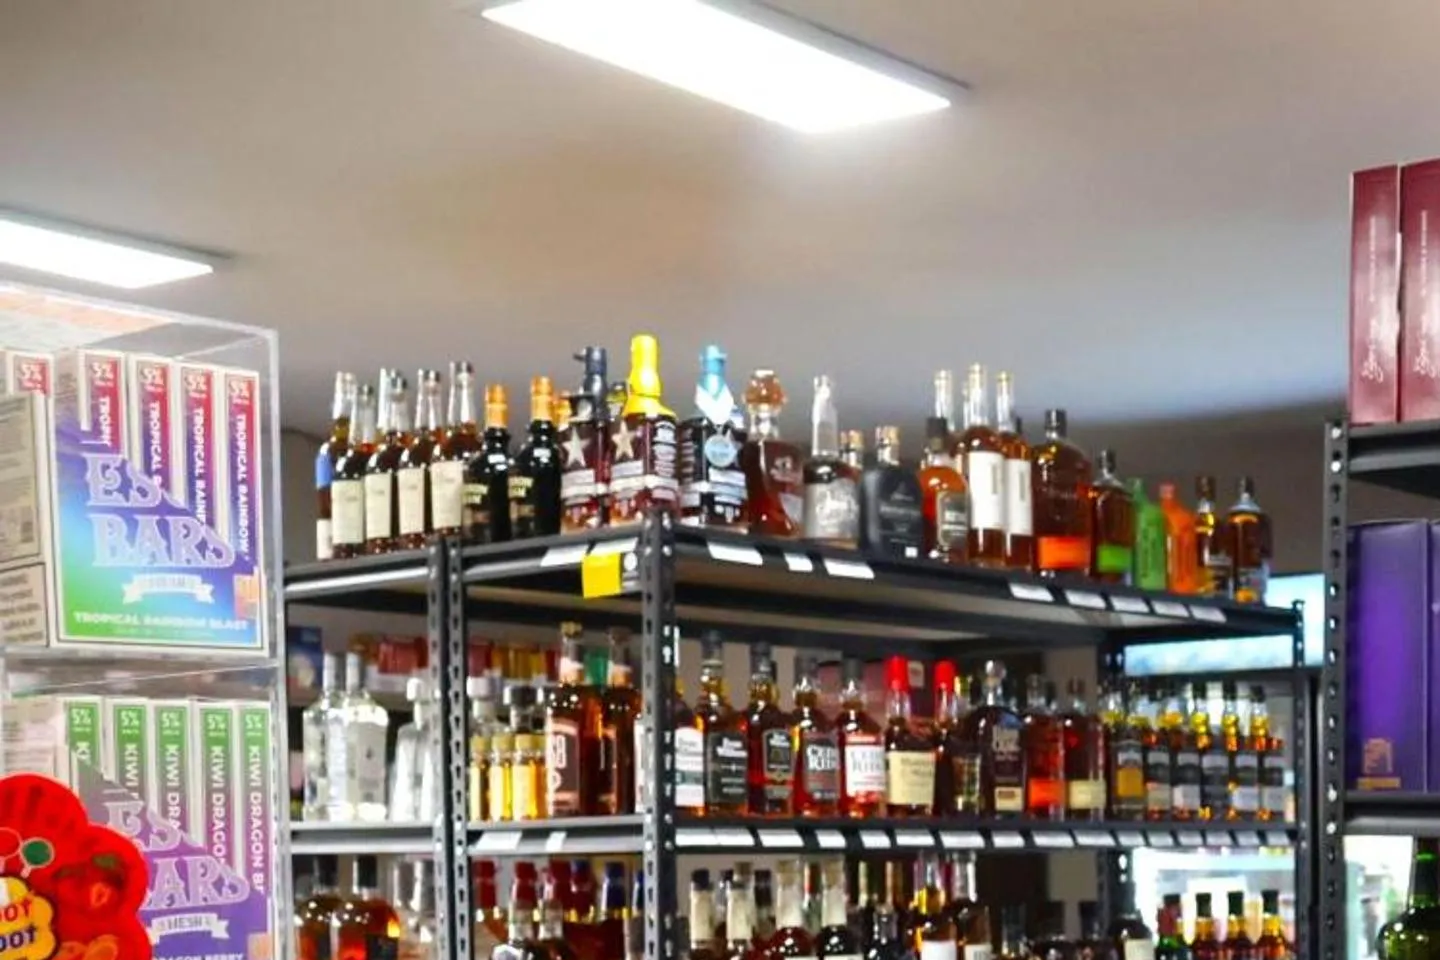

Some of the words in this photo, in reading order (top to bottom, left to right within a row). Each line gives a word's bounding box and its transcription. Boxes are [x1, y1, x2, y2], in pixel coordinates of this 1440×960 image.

[193, 408, 206, 477] TROPICAL
[236, 414, 249, 479] TROPICAL
[72, 707, 91, 725] 5%
[121, 711, 140, 727] 5%
[162, 712, 180, 728] 5%
[207, 714, 226, 729] 5%
[245, 714, 262, 729] 5%
[125, 744, 139, 787] KIWI
[165, 744, 179, 787] KIWI
[211, 745, 225, 788] KIWI
[248, 745, 261, 787] KIWI
[250, 792, 264, 868] DRAGON
[140, 856, 251, 911] ARS
